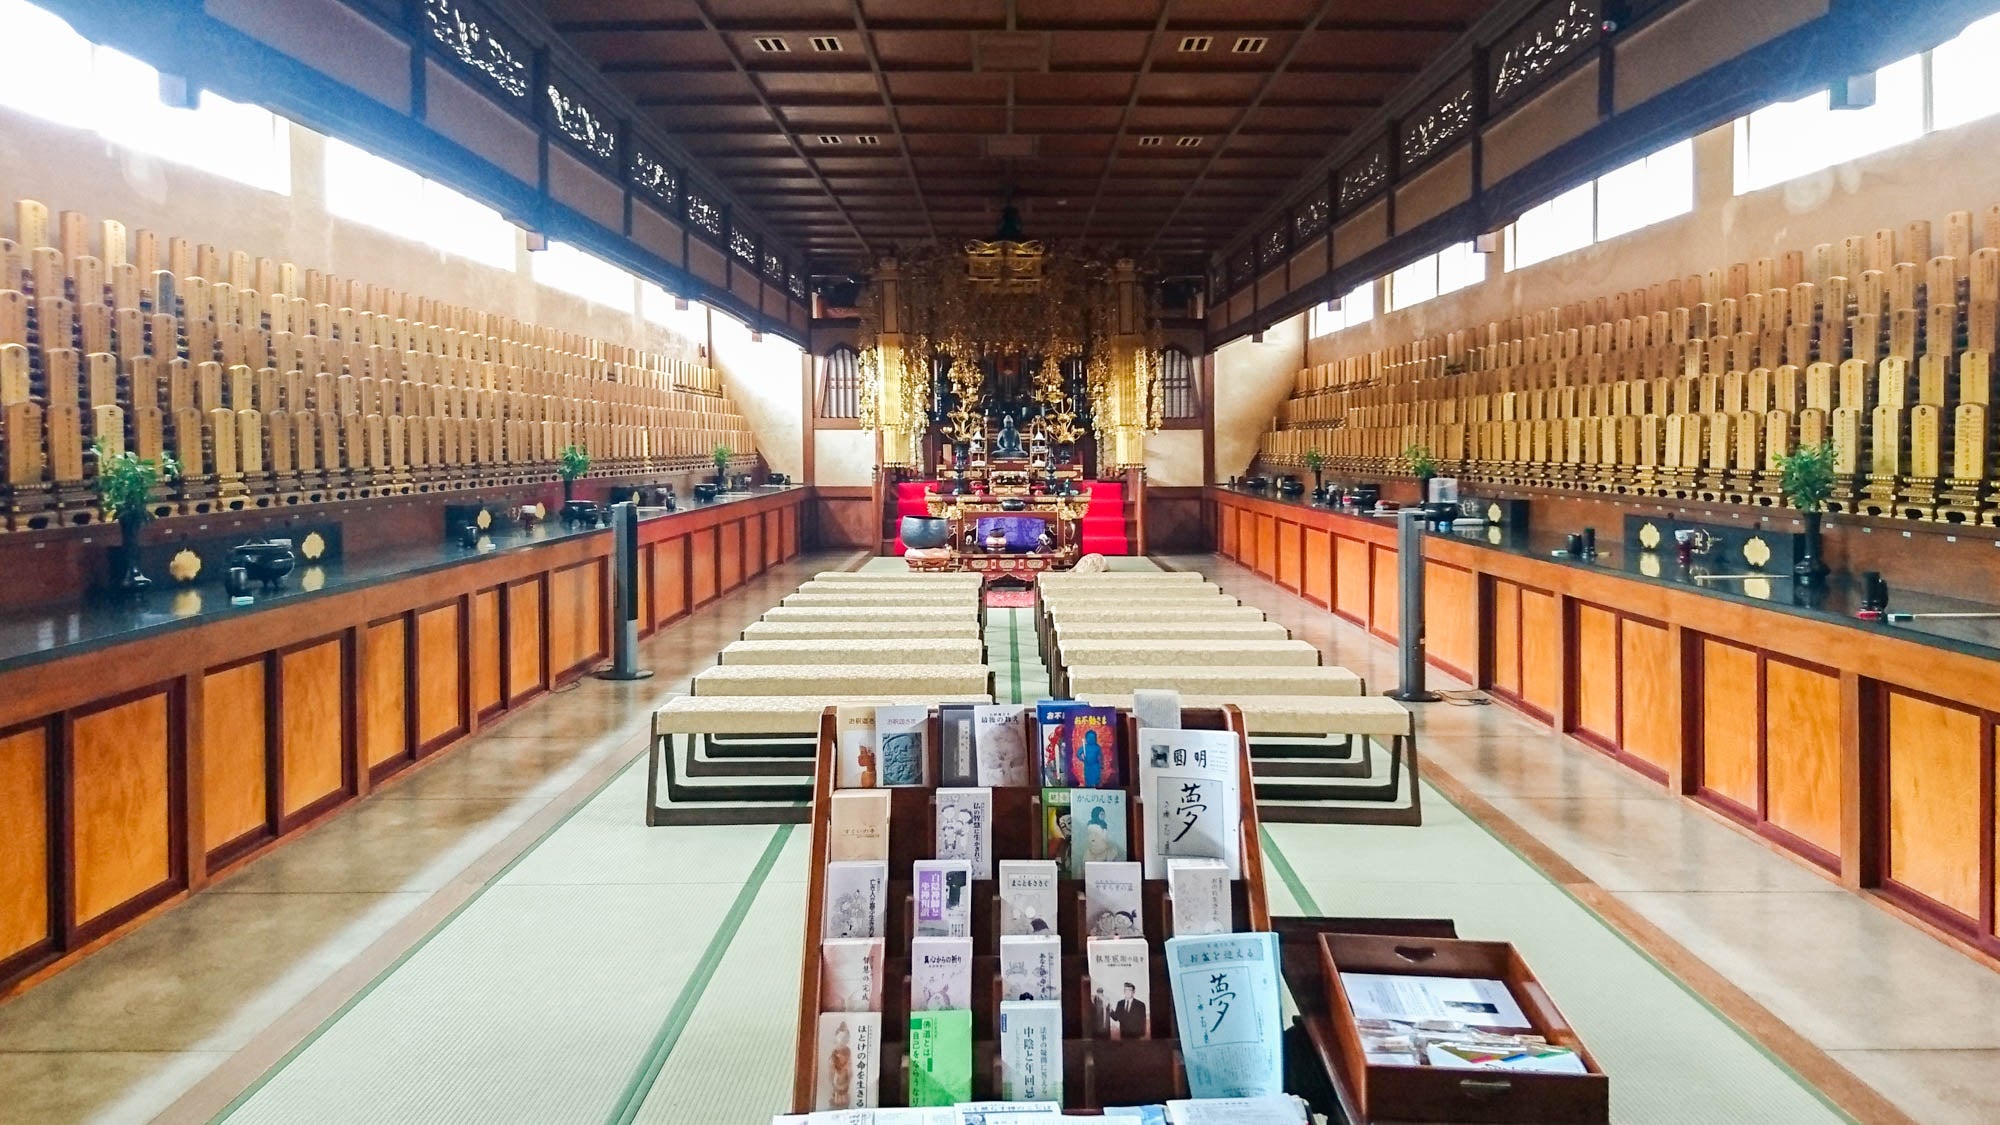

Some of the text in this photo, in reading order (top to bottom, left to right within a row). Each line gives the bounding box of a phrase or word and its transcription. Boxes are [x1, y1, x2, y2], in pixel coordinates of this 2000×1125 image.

[1046, 711, 1064, 720] お不
[1075, 715, 1107, 725] お不動さま
[1077, 794, 1120, 804] かんのんさま
[1172, 783, 1207, 843] 夢
[1209, 973, 1236, 1033] 夢
[856, 1025, 867, 1108] ほとけの命を生きる
[1023, 1025, 1036, 1099] 中陰と年回忌
